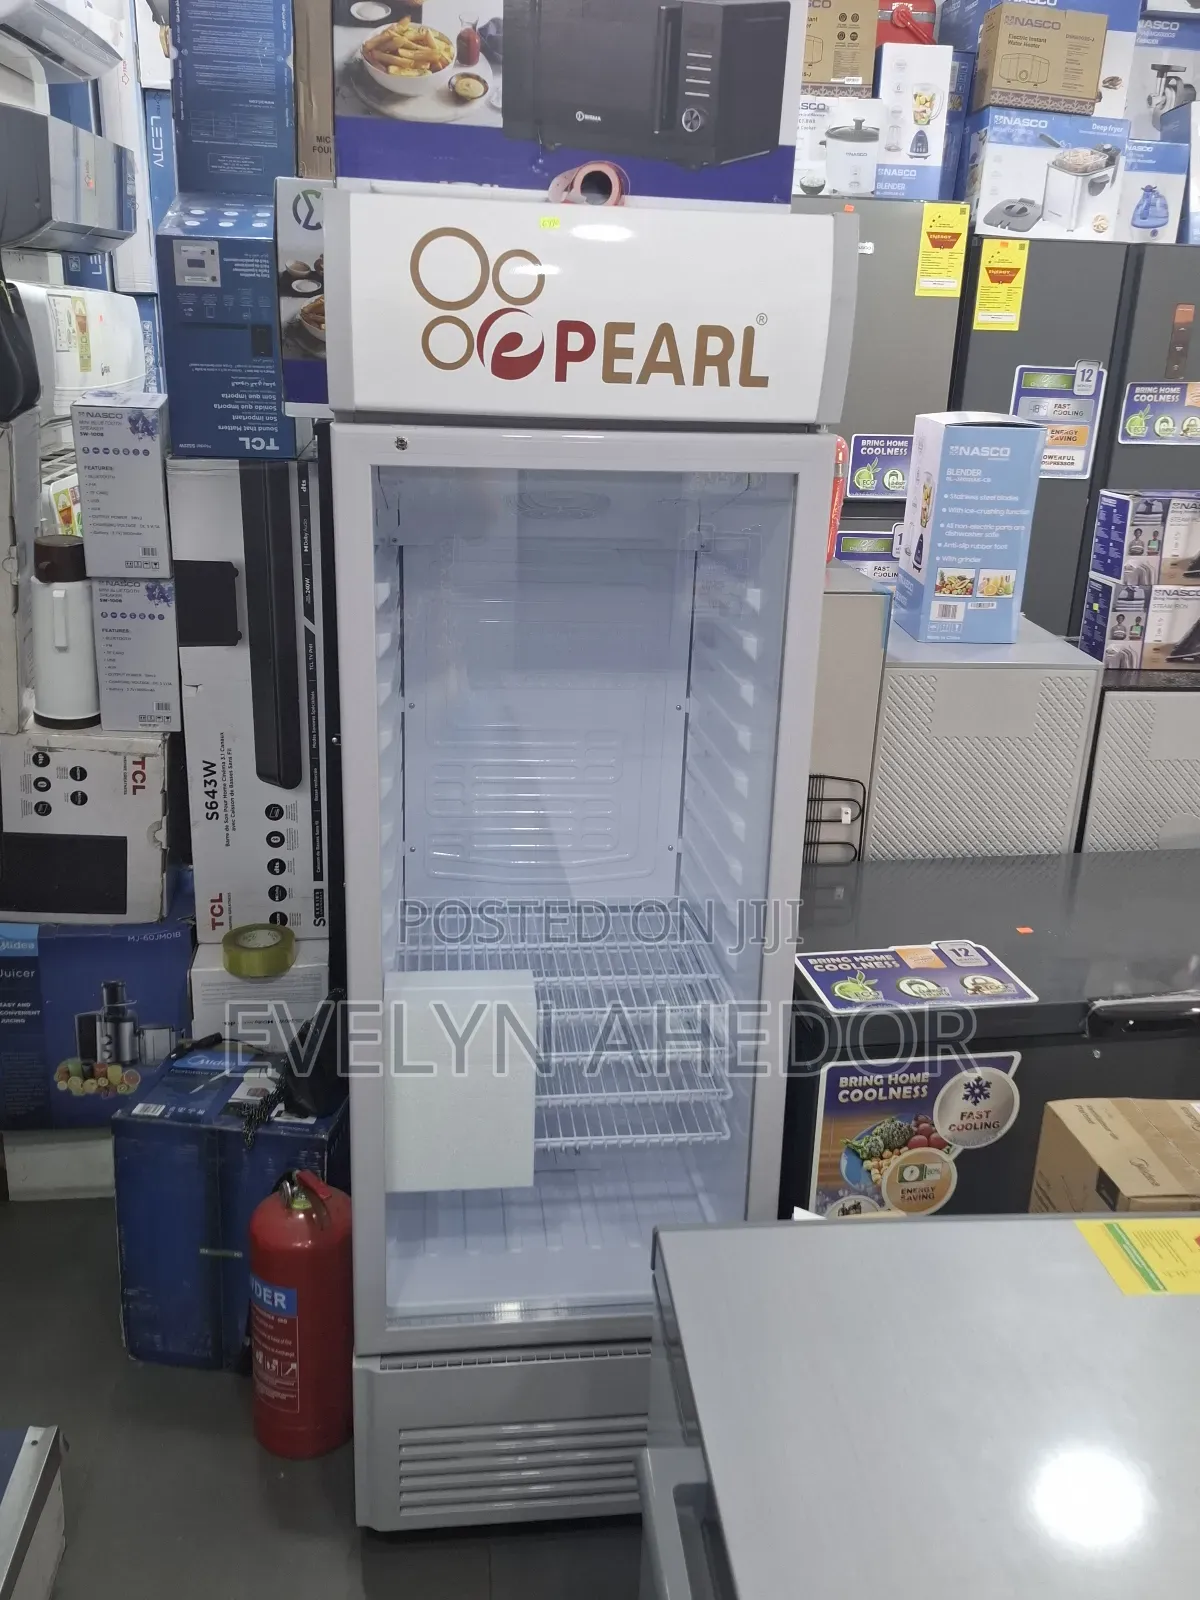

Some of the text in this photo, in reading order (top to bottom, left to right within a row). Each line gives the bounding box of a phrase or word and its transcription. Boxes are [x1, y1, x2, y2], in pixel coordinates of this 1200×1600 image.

[1014, 17, 1061, 30] NASCO
[1002, 116, 1049, 129] NASCO
[1092, 123, 1124, 133] Deep fryer
[883, 168, 917, 177] NASCO
[876, 182, 906, 190] BLENDER
[554, 319, 770, 389] PEARL
[1079, 368, 1094, 382] 12
[1135, 386, 1158, 394] BRING
[1133, 394, 1180, 403] COOLNESS
[86, 411, 123, 419] NASCO
[217, 424, 242, 432] Matters
[238, 436, 280, 451] TCL
[861, 439, 885, 447] BRING
[860, 447, 908, 456] COOLNESS
[958, 446, 1011, 457] NASCO
[946, 467, 982, 477] BLENDER
[995, 524, 1013, 532] parts
[944, 530, 984, 538] dishwasher
[943, 542, 970, 550] Anti-slip
[957, 556, 982, 565] grinder
[105, 580, 141, 588] NASCO
[131, 756, 147, 796] TCL
[202, 759, 219, 821] S643W
[229, 789, 235, 797] de
[224, 824, 230, 832] de
[210, 892, 224, 931] TCL
[0, 938, 36, 951] Midea
[948, 947, 974, 958] 12
[807, 954, 896, 965] BRING HOME
[813, 960, 901, 973] COOLNESS
[0, 968, 36, 978] Juicer
[838, 1072, 930, 1088] BRING HOME
[837, 1084, 929, 1103] COOLNESS
[960, 1109, 992, 1121] FAST
[948, 1121, 1001, 1132] COOLING
[900, 1186, 936, 1196] ENERGY
[900, 1192, 936, 1202] SAVING
